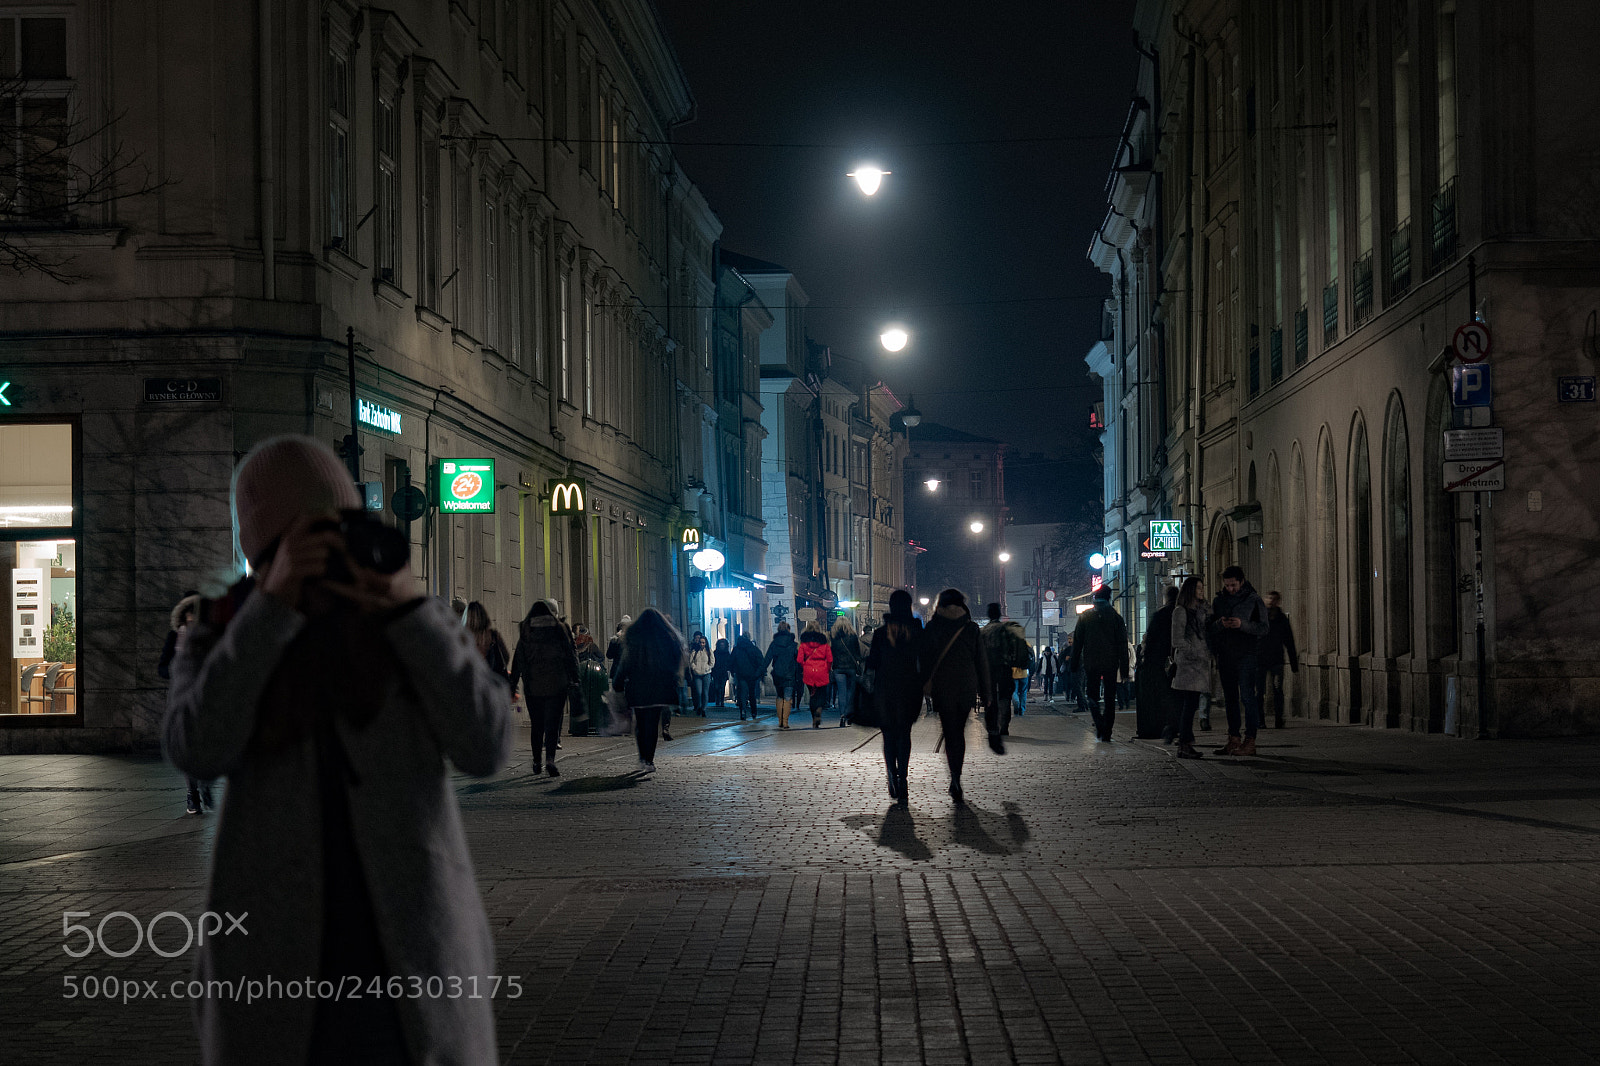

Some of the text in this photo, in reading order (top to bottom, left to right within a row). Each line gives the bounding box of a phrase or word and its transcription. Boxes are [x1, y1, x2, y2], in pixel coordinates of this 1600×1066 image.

[1461, 368, 1482, 401] P
[1569, 384, 1587, 399] 31
[179, 391, 217, 400] GŁÓWNY
[359, 398, 371, 424] Bank
[456, 477, 475, 492] 24
[1152, 523, 1180, 534] TAK
